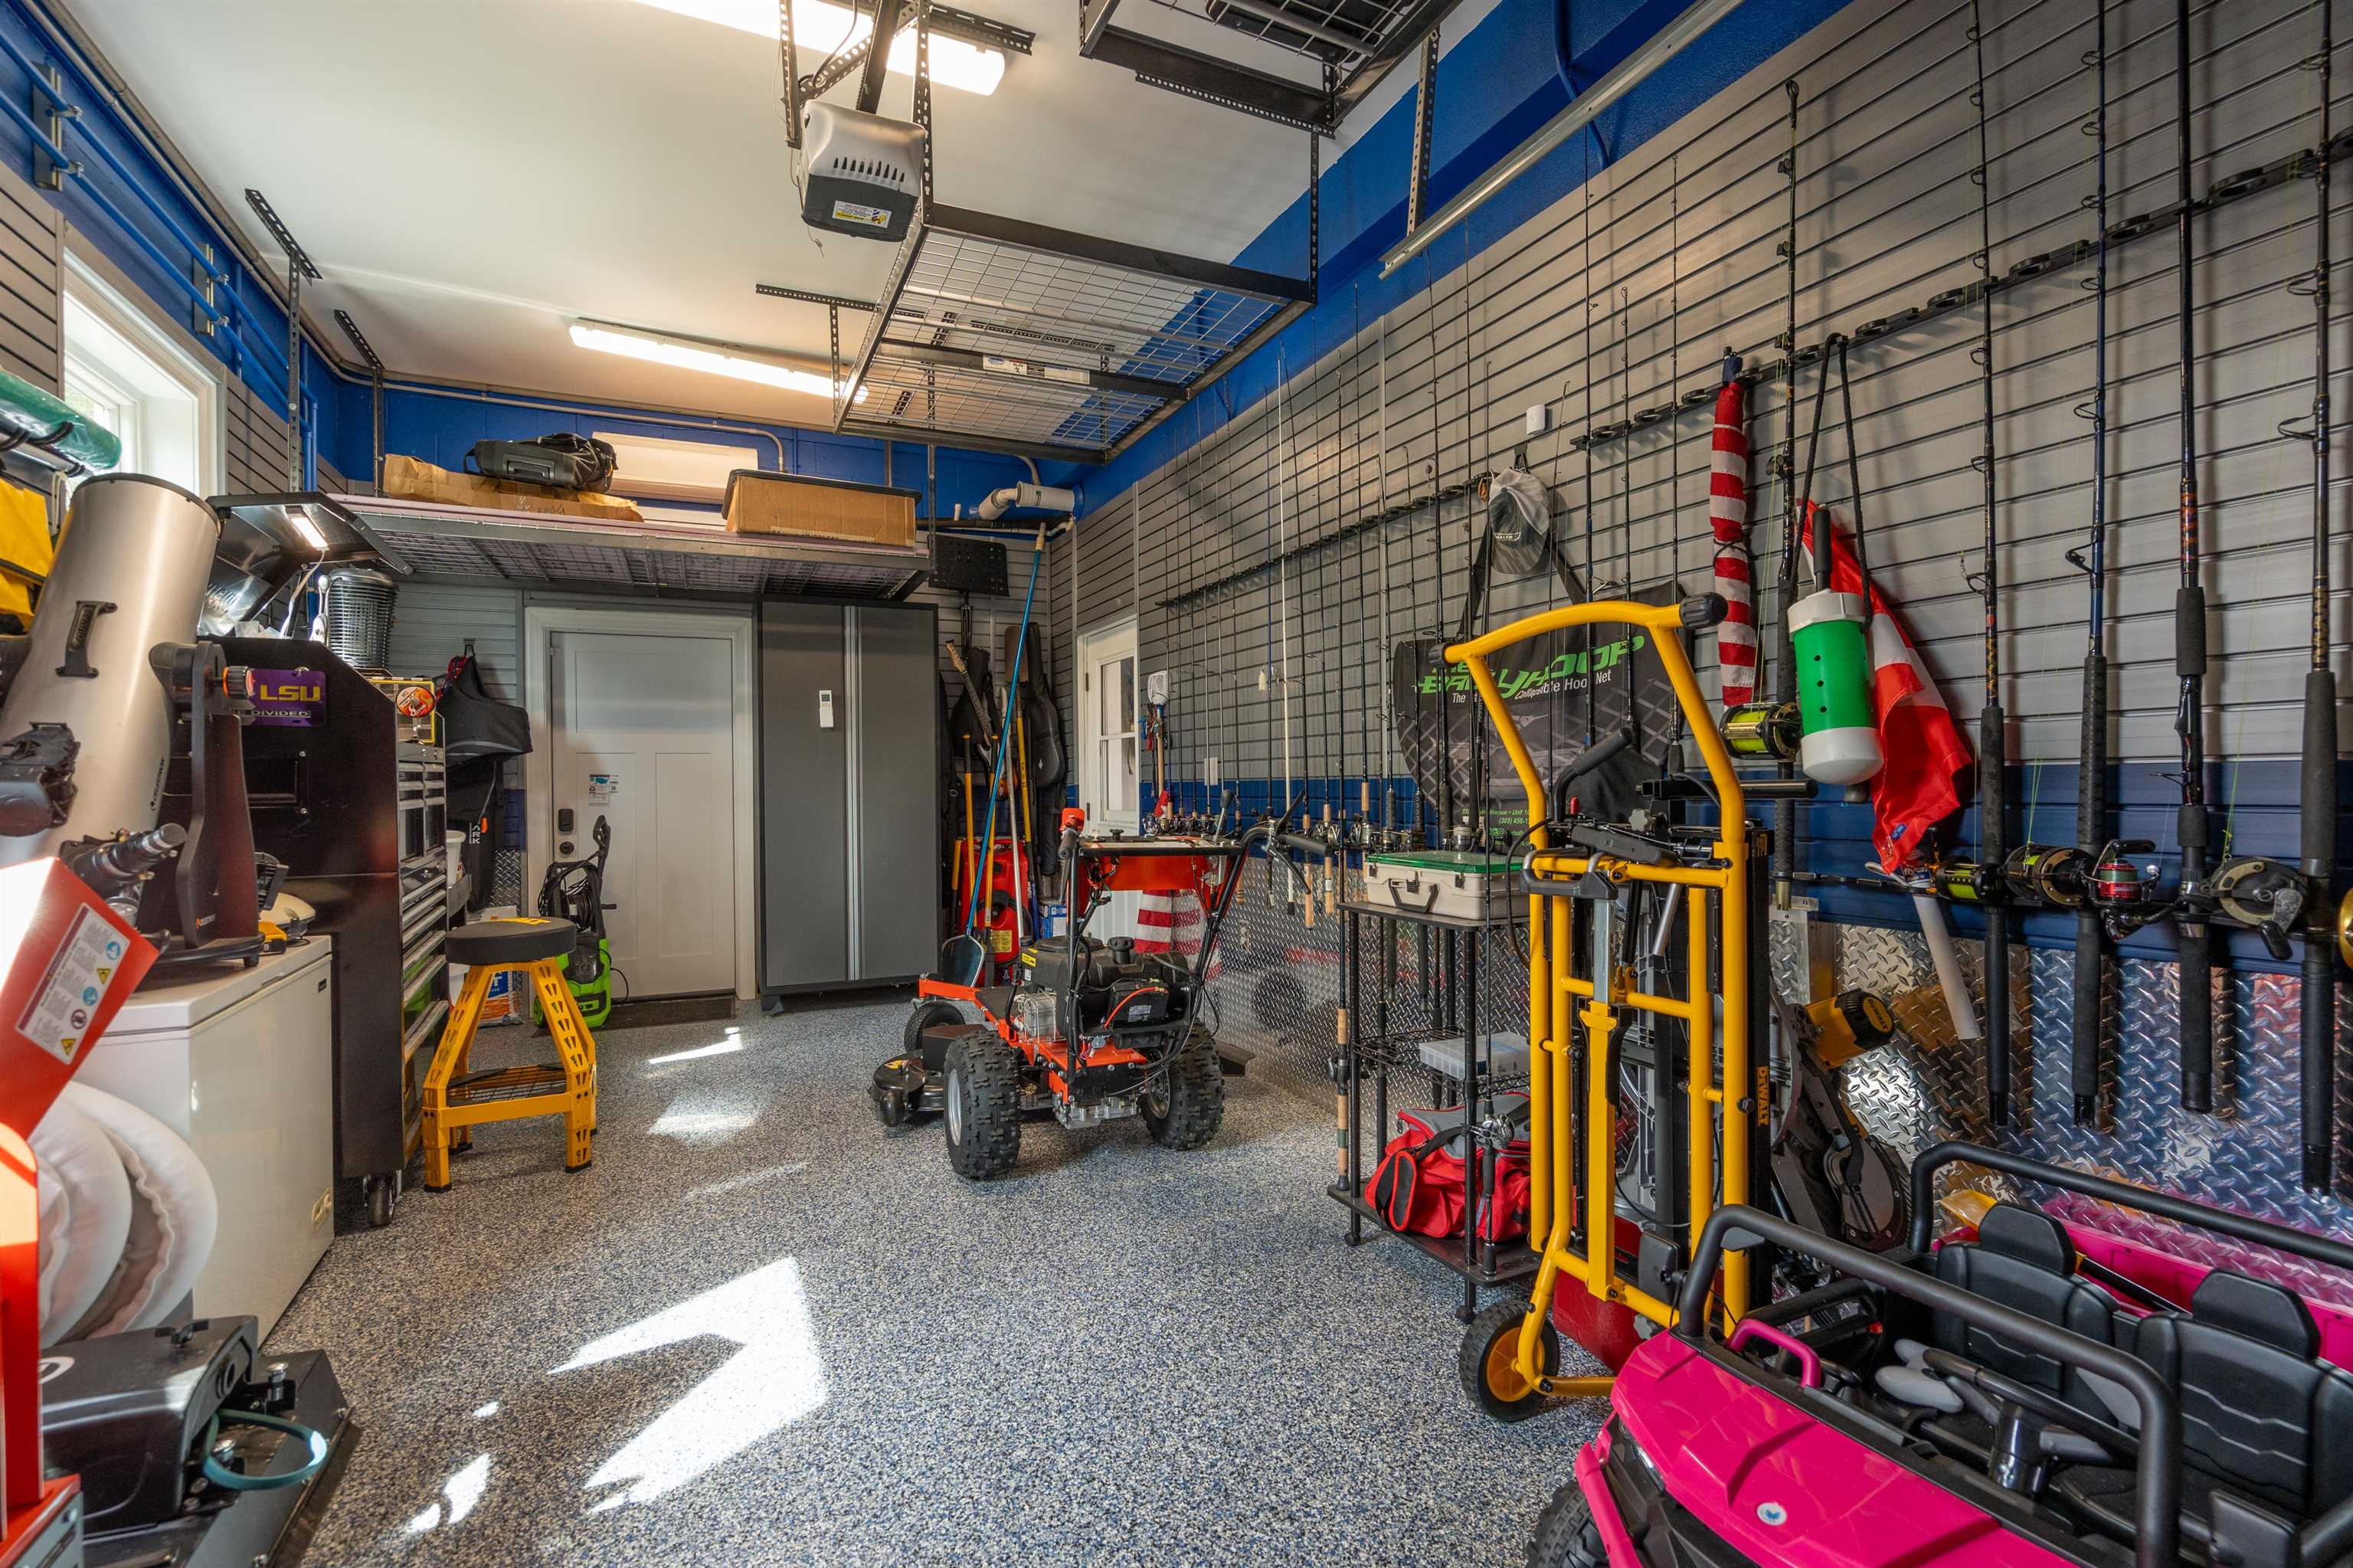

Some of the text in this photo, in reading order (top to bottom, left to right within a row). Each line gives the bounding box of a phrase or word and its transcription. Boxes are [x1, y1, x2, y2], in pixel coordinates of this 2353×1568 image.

[1565, 678, 1588, 690] Hoo
[1595, 669, 1612, 685] Net
[260, 685, 320, 702] LSU
[1452, 692, 1466, 703] The
